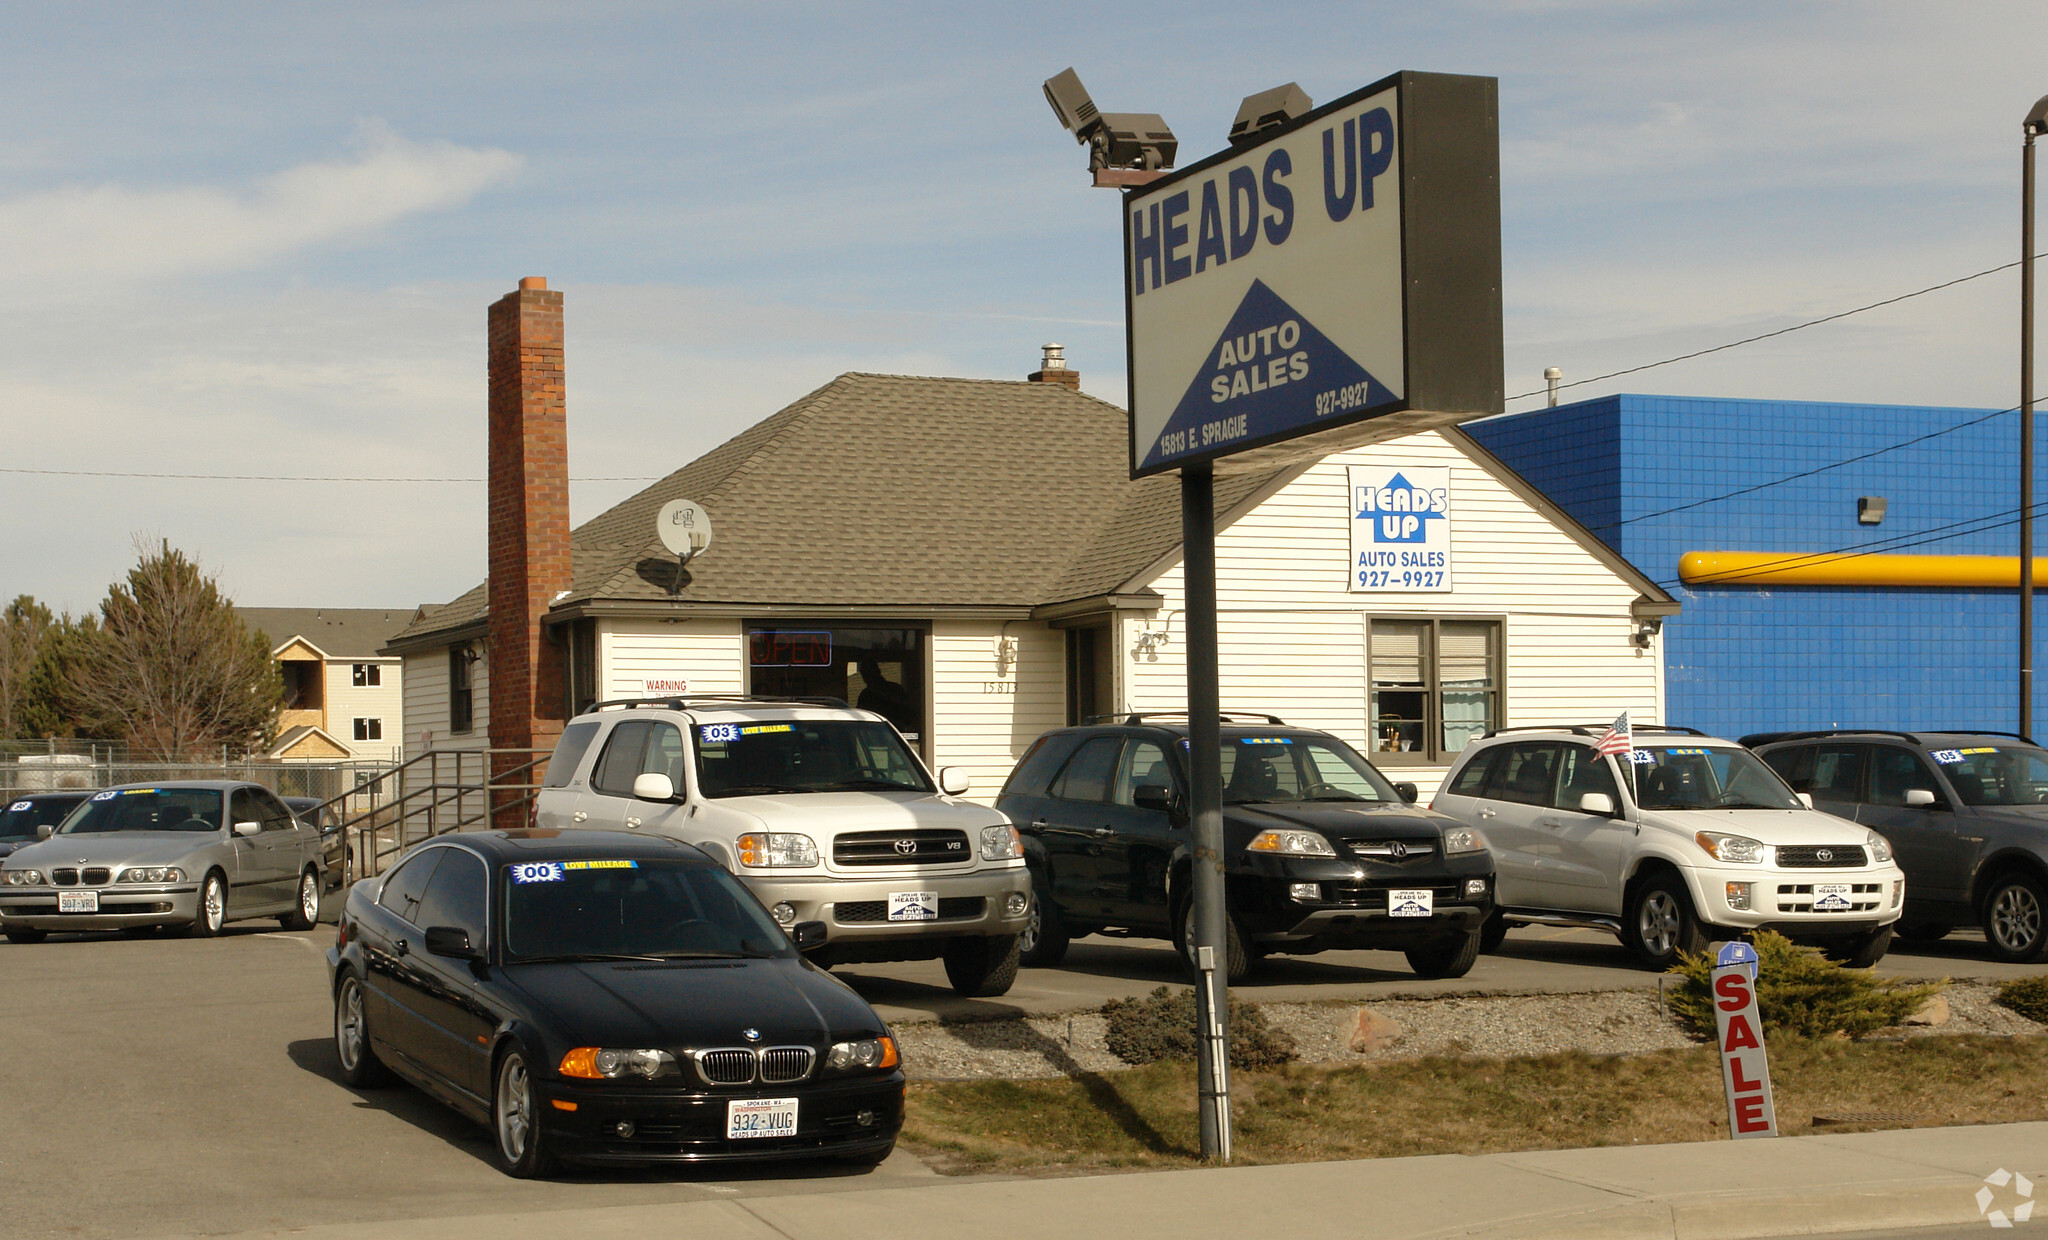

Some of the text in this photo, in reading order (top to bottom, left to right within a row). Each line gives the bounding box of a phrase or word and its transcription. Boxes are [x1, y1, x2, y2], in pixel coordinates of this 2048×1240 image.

[1133, 106, 1395, 296] HEADS UP
[1217, 319, 1301, 370] AUTO
[1211, 351, 1309, 404] SALES
[1315, 381, 1368, 417] 927-9927
[1160, 413, 1247, 457] 15813 E. SPRAGUE
[1356, 486, 1447, 513] HEADS
[1382, 515, 1419, 539] UP
[1358, 551, 1444, 567] AUTO SALES
[1359, 571, 1444, 587] 927-9927
[749, 634, 829, 663] OPEN
[646, 680, 687, 691] WARNING
[984, 682, 1018, 694] 15813
[711, 727, 730, 738] 03
[742, 724, 791, 735] LOW MILEAGE
[1940, 752, 1956, 760] 05
[947, 842, 961, 850] V8
[524, 865, 551, 878] 00
[564, 860, 632, 870] LOW MILEAGE
[1715, 974, 1769, 1133] SALE
[733, 1112, 793, 1131] 932-VUG
[776, 1129, 793, 1137] SALES
